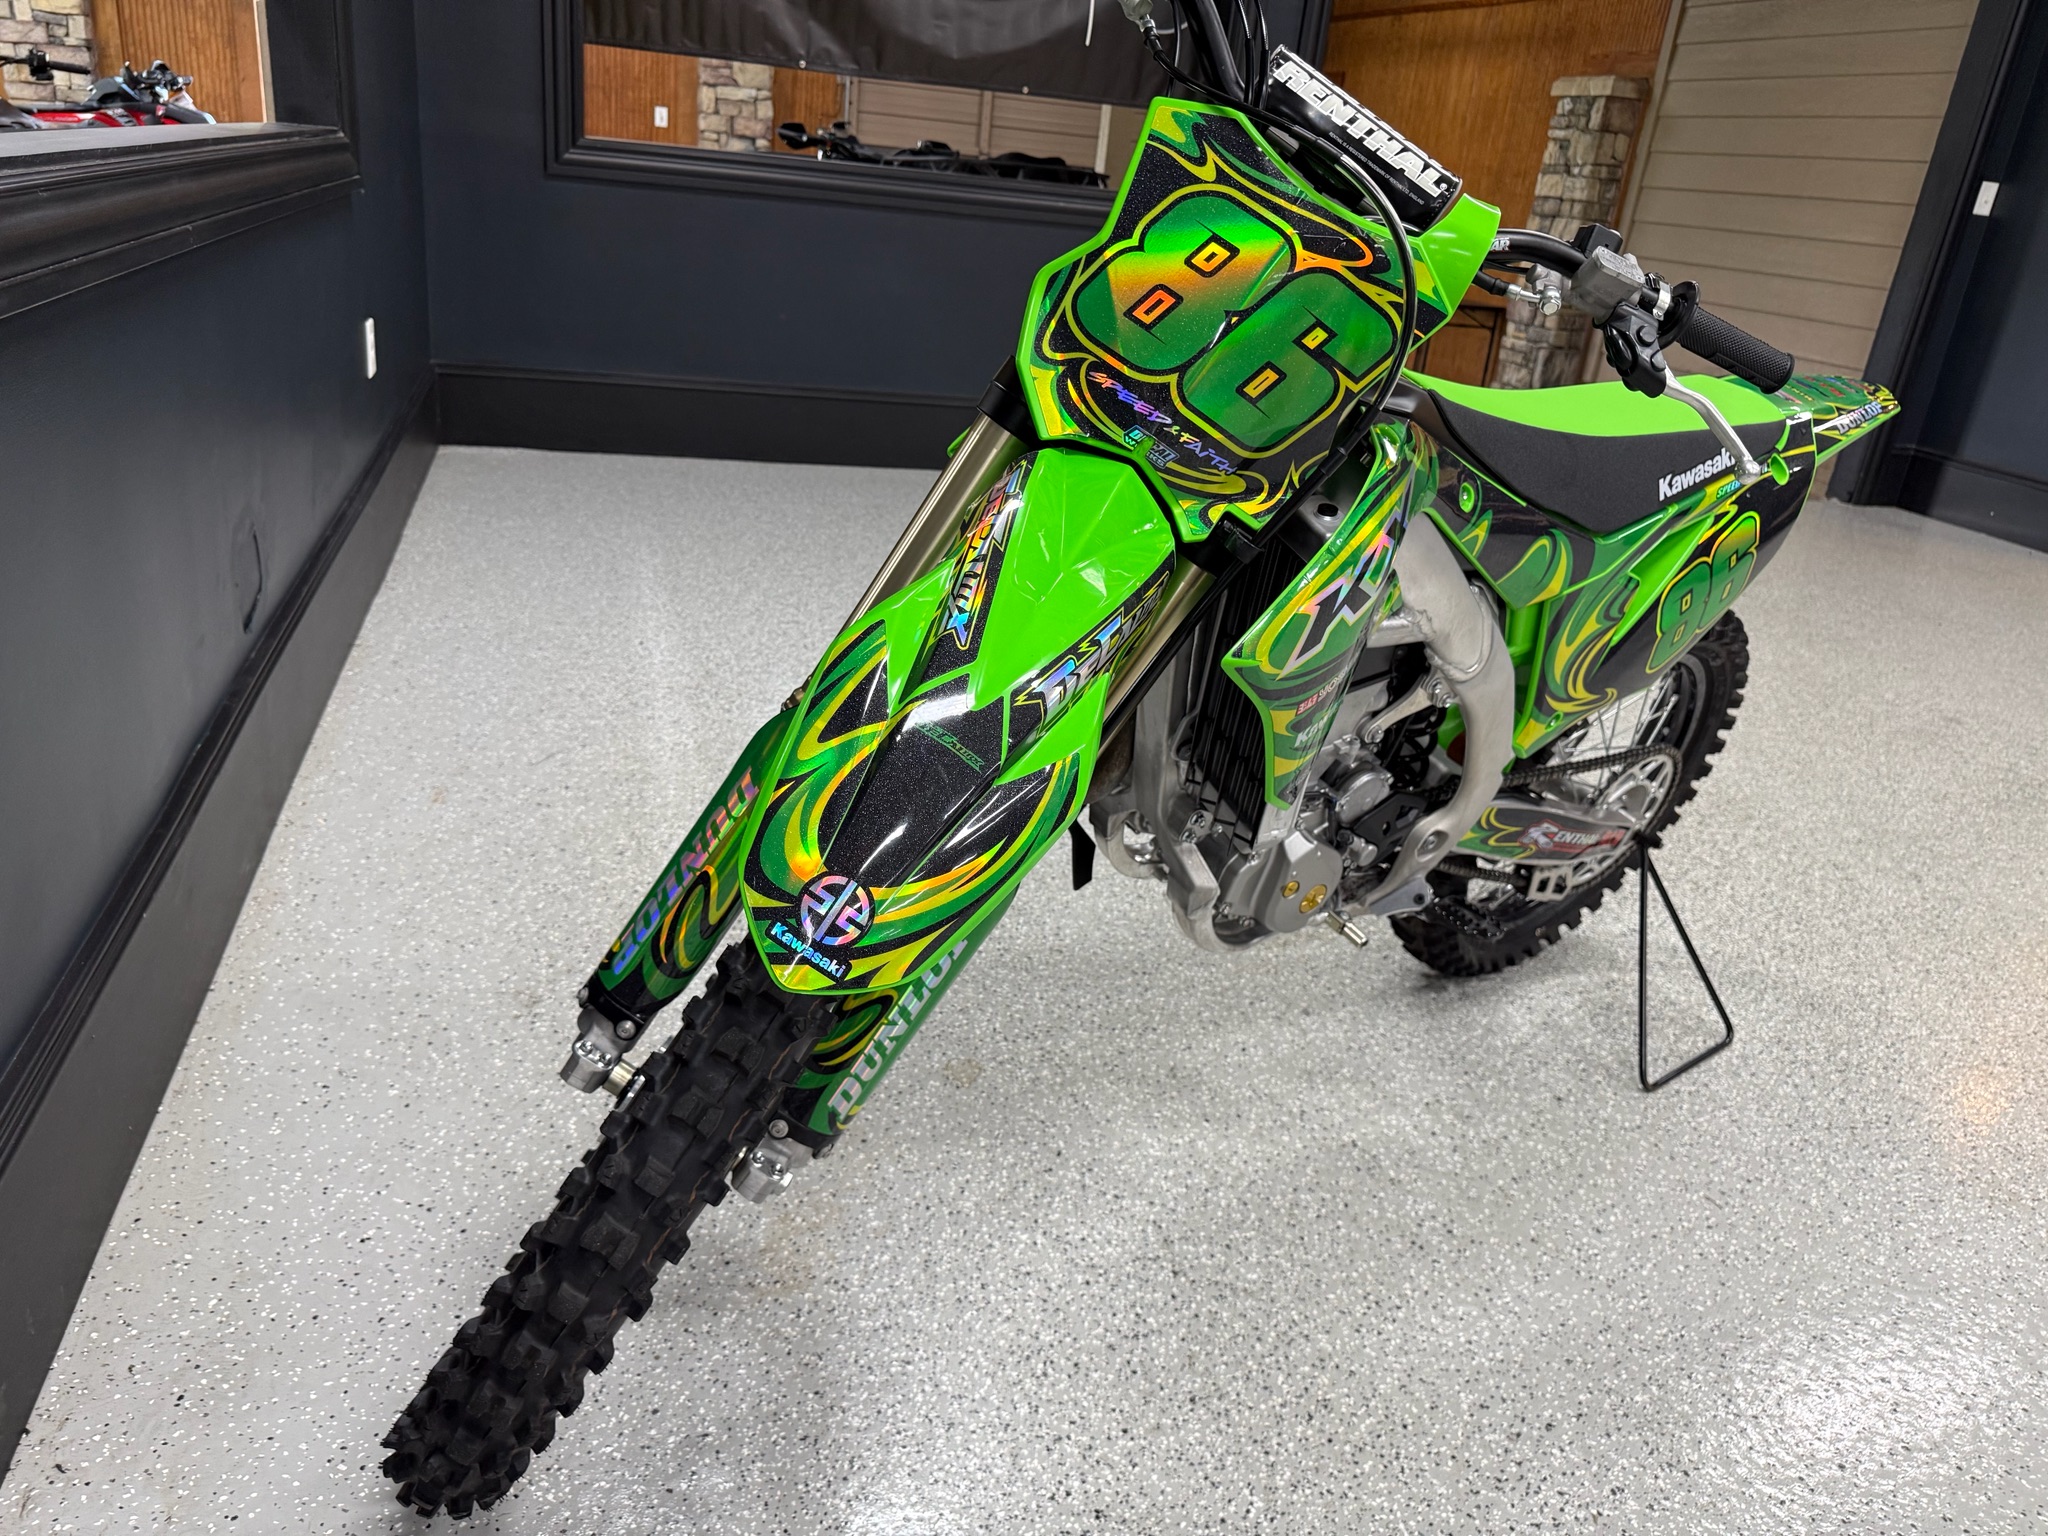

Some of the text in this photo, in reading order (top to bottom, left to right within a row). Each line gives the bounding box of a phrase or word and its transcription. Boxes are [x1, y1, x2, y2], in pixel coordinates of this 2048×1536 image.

[1273, 60, 1442, 197] RENTHAL
[1074, 193, 1394, 448] 86
[1087, 371, 1172, 425] SPEED
[1837, 401, 1883, 435] DUNLOP
[1125, 435, 1166, 467] WKS
[1128, 428, 1177, 462] DCAL
[1646, 511, 1760, 674] 86
[614, 766, 759, 974] DUNLOP
[771, 921, 846, 979] Kawasaki
